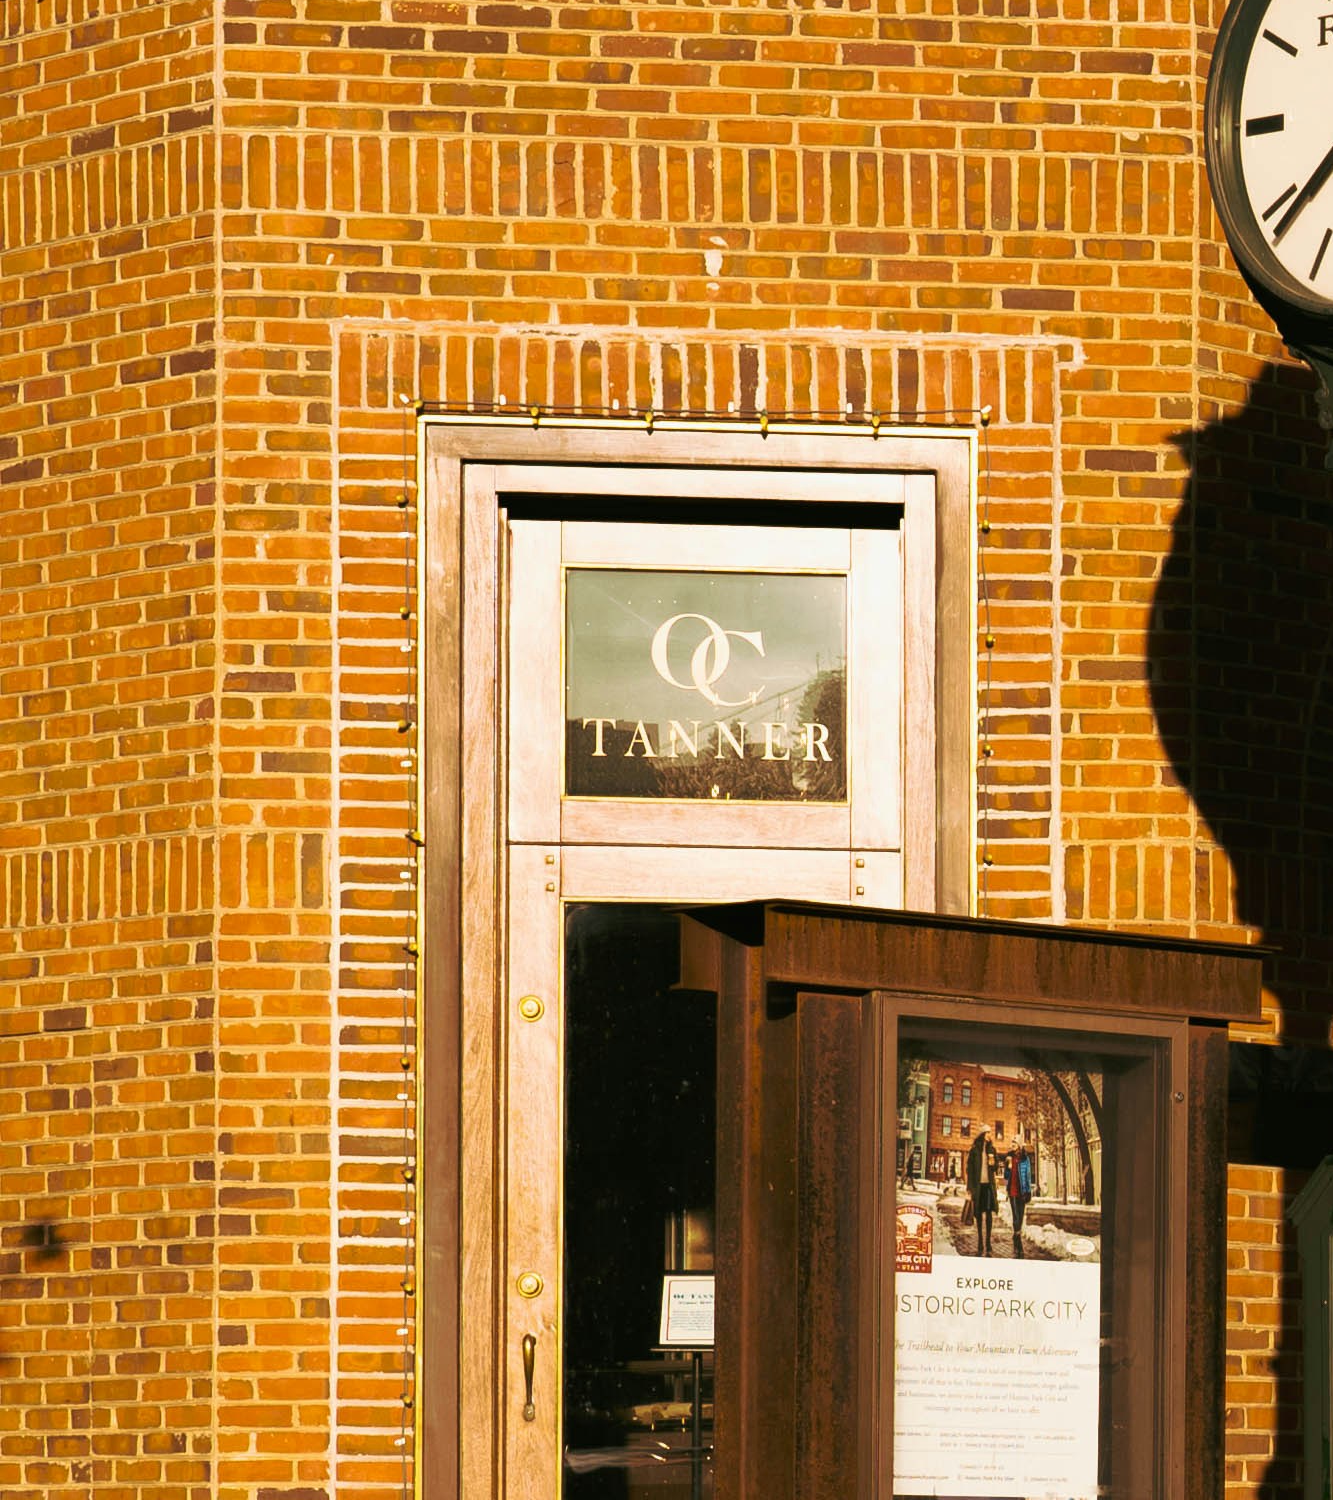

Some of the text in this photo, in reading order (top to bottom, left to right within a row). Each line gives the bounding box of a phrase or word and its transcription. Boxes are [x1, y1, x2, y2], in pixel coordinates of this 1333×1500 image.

[583, 718, 833, 762] TANNER
[896, 1255, 931, 1265] ARK CITY
[956, 1277, 1014, 1291] EXPLORE
[895, 1294, 1087, 1320] ISTORIC PARK CITY
[975, 1342, 1015, 1355] Mountain
